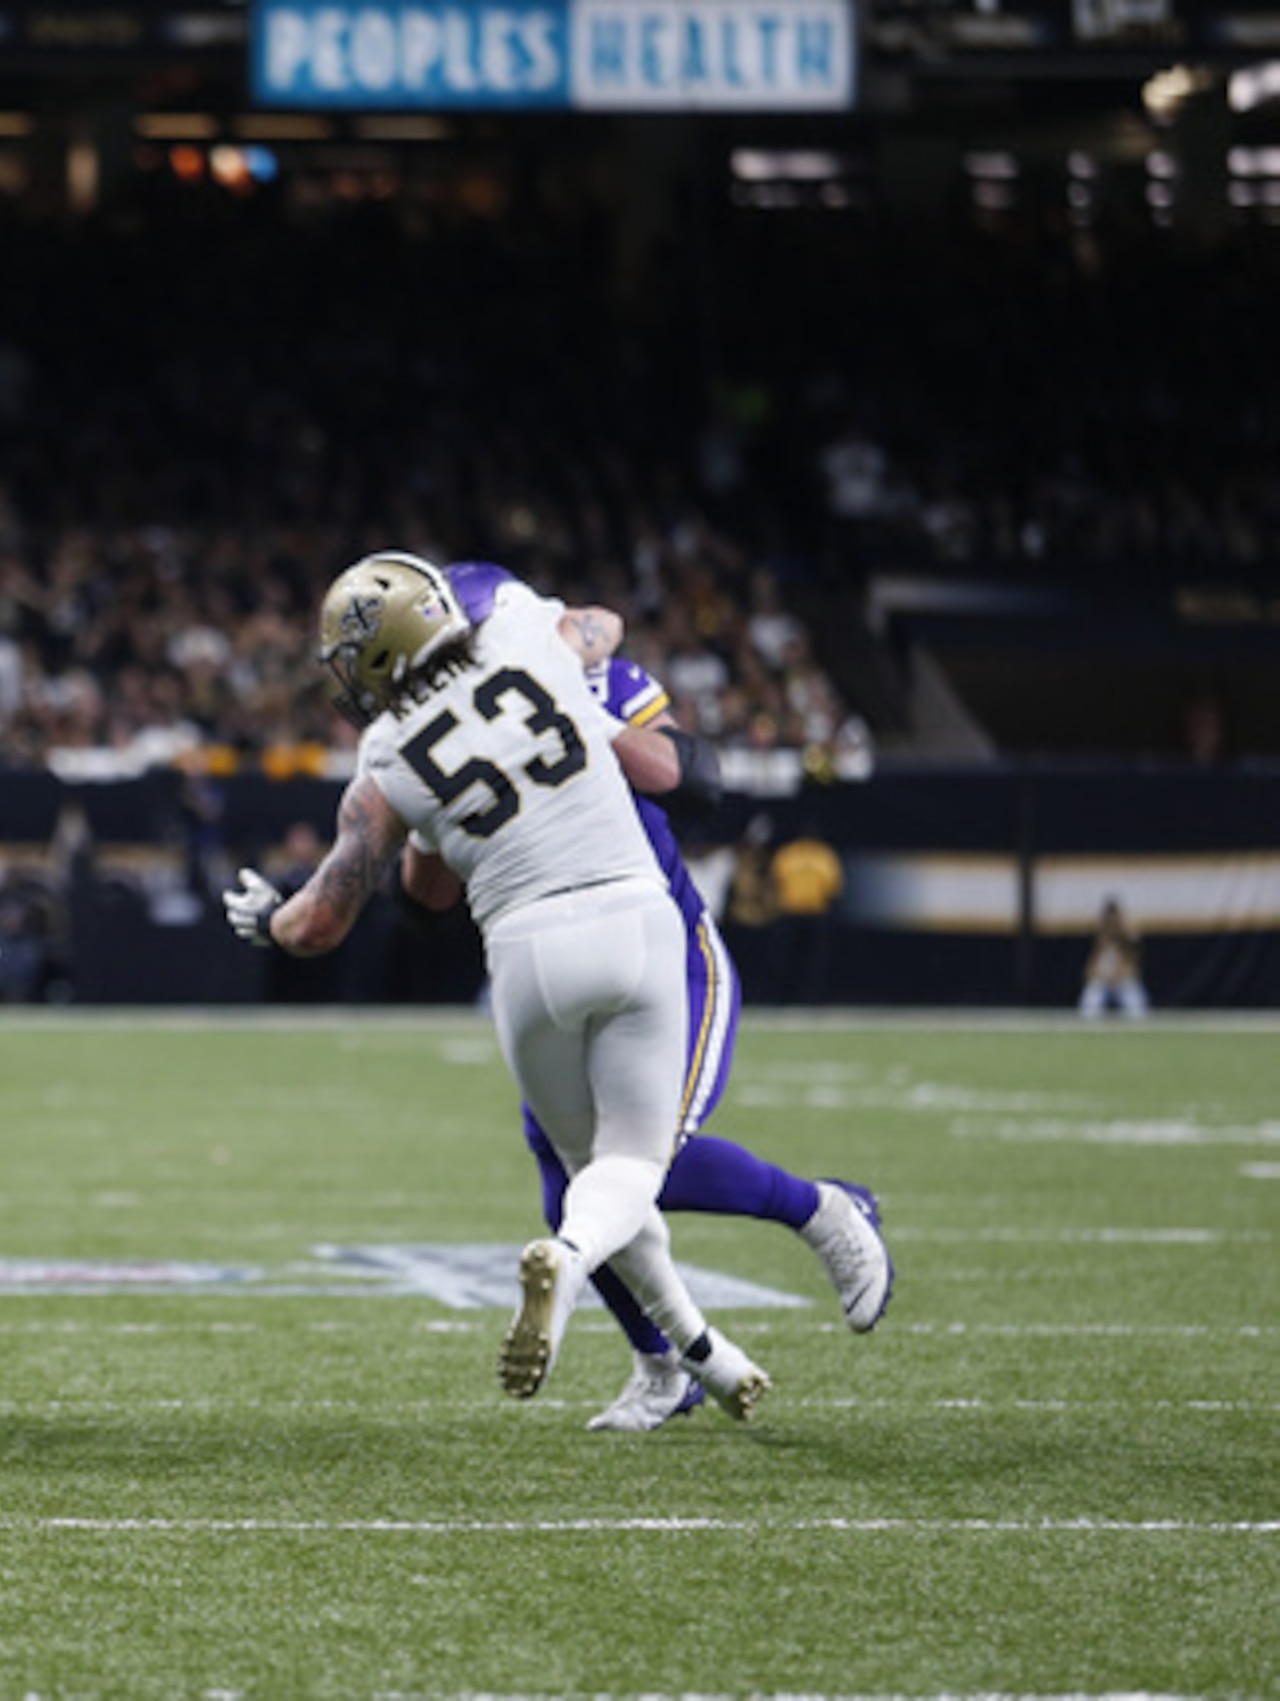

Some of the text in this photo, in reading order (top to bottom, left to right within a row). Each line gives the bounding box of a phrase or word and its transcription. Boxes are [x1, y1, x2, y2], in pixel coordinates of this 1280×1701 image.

[265, 8, 836, 92] PEOPLES HEALTH
[397, 666, 588, 839] 53
